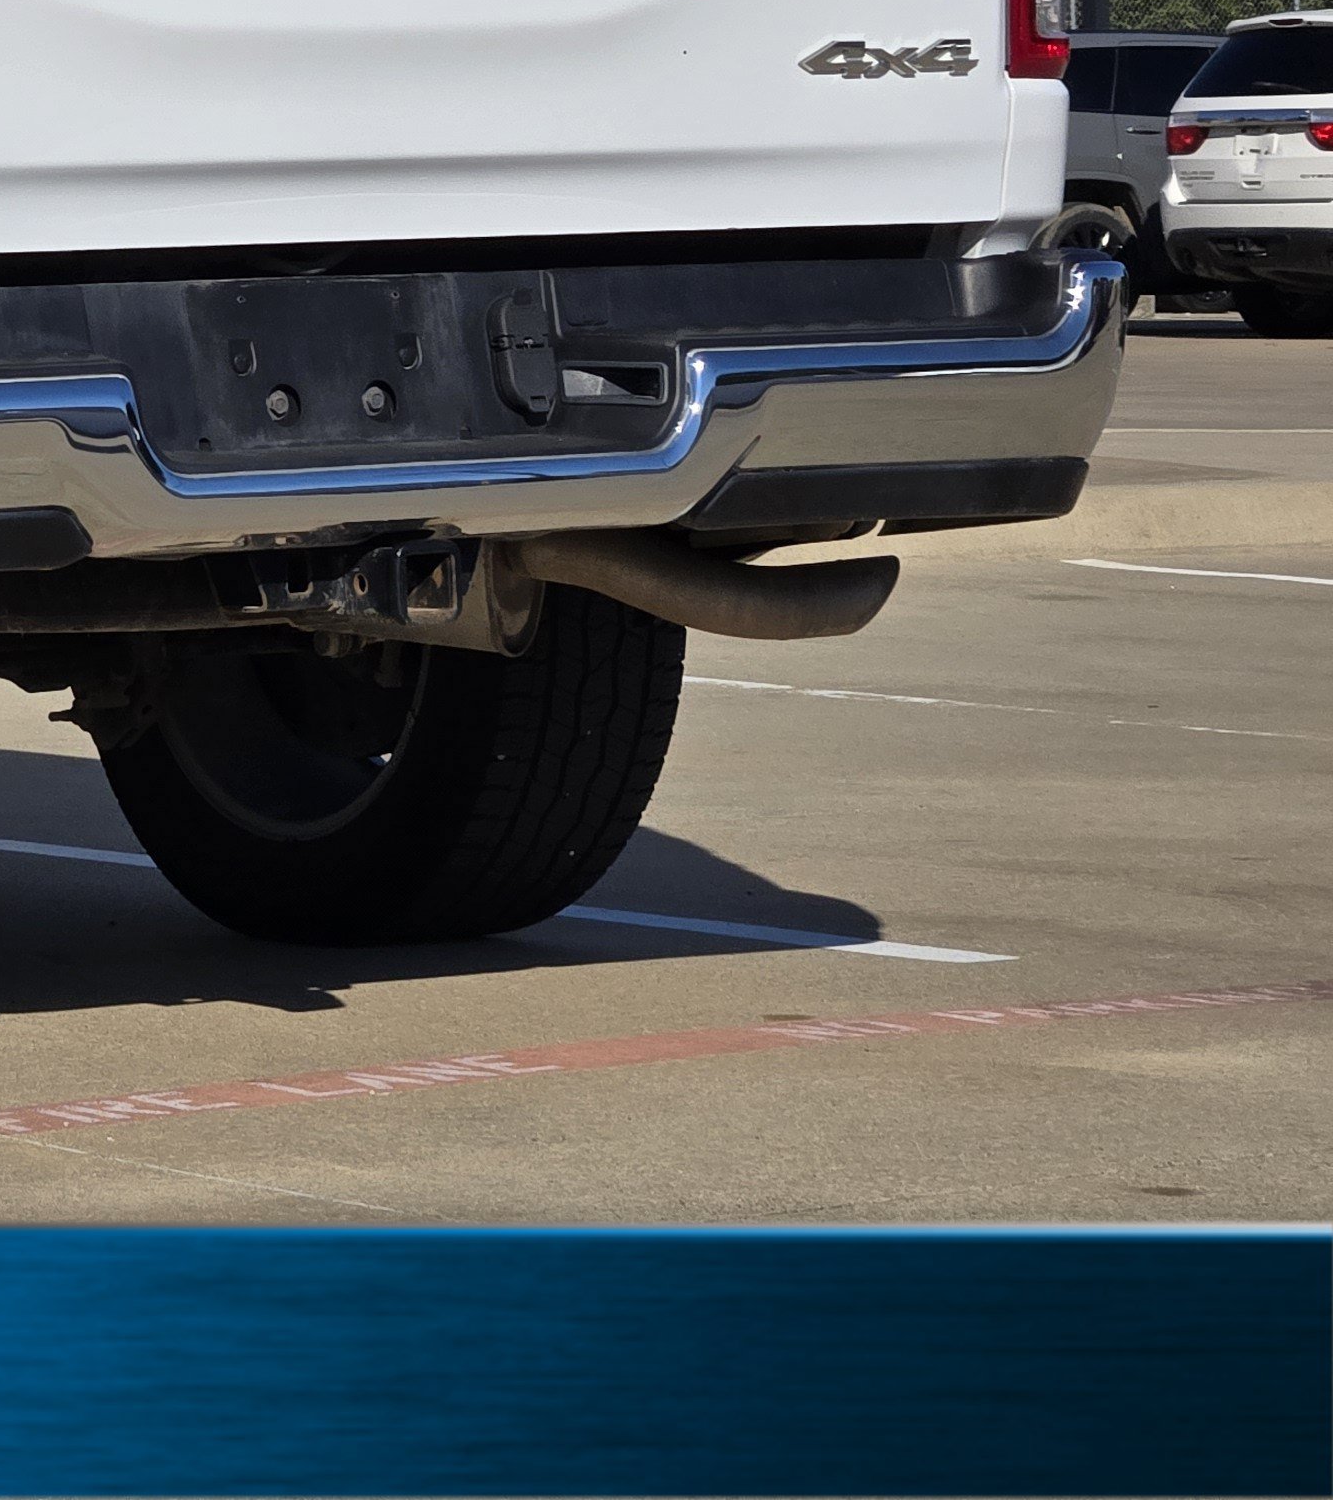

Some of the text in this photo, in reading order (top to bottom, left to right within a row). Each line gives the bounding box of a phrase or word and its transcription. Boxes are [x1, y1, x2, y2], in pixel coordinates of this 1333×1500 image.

[798, 38, 980, 80] 4x4
[246, 1054, 564, 1098] LANE
[754, 1019, 921, 1043] NO
